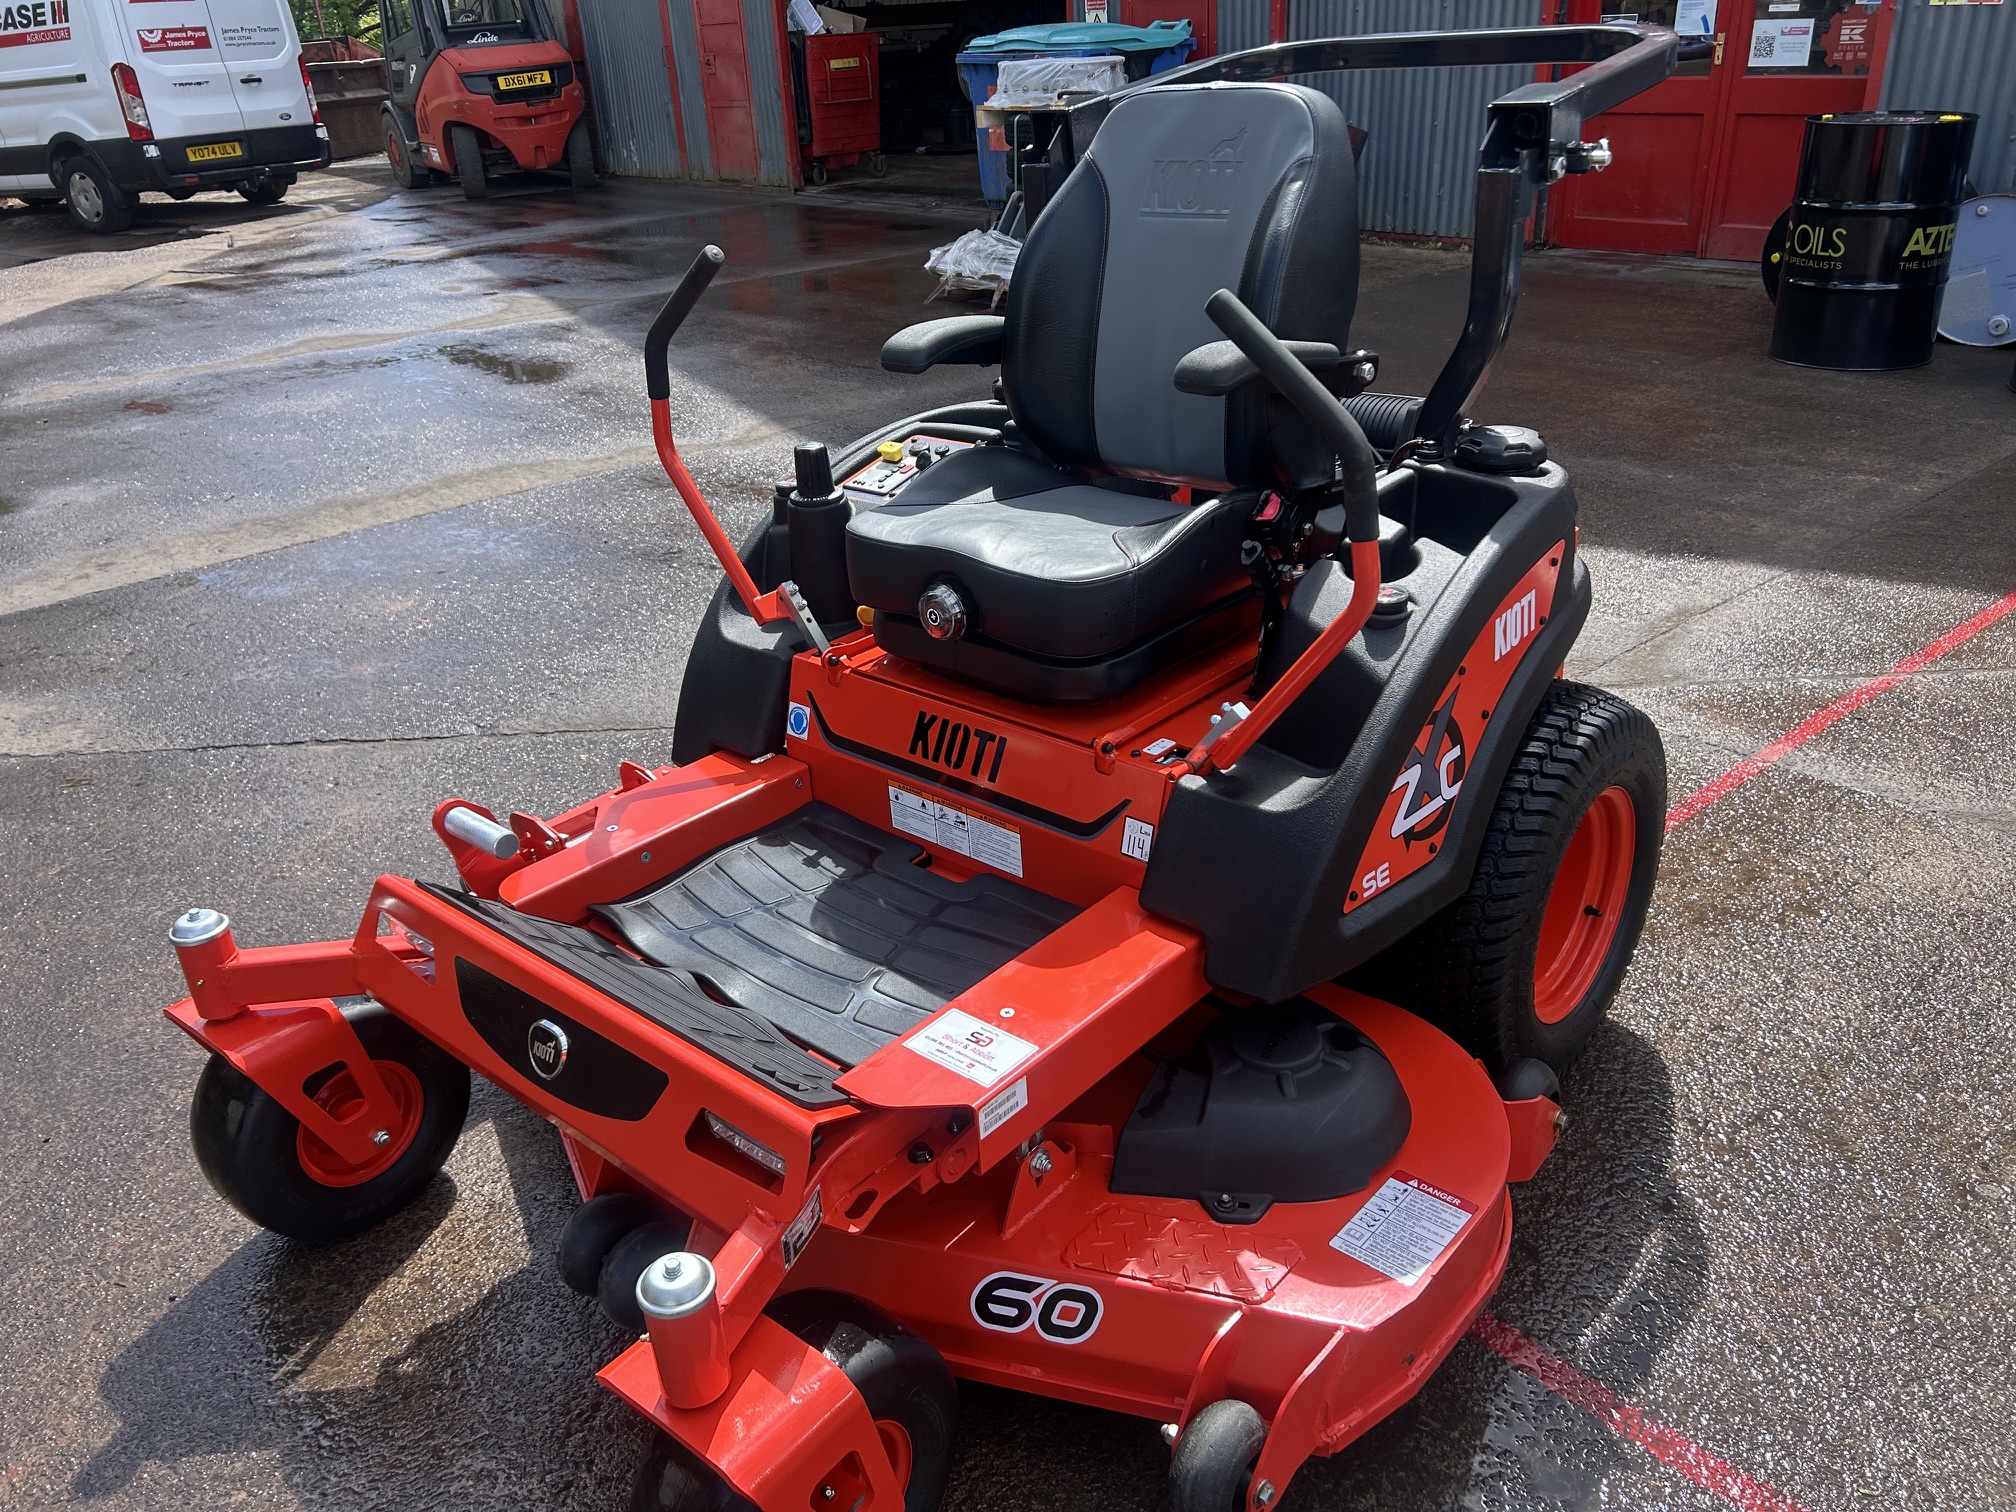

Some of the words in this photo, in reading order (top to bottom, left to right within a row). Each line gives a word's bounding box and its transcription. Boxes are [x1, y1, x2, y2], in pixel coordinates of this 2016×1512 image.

[0, 2, 47, 31] ASE
[26, 29, 70, 43] AGRICULTURE
[165, 31, 187, 39] James
[187, 30, 206, 38] Pryce
[221, 27, 240, 35] James
[240, 26, 257, 34] Pryce
[257, 25, 280, 33] Tractors
[467, 31, 499, 44] Linde
[504, 75, 526, 88] DX61
[526, 73, 546, 84] MFZ
[190, 145, 217, 159] YO74
[217, 144, 236, 156] ULV
[1140, 159, 1244, 212] KIOTI
[1794, 224, 1847, 258] OILS
[1789, 257, 1842, 270] SPECIALISTS
[1900, 261, 1919, 270] THE
[1494, 588, 1536, 662] KIOTI
[908, 709, 1008, 784] KIOTI
[1127, 834, 1145, 858] 114
[1363, 861, 1390, 899] SE
[533, 1040, 555, 1064] KIOTI
[942, 1034, 963, 1046] Short
[969, 1047, 995, 1061] Abbott
[1420, 1184, 1460, 1205] DANGER
[970, 1271, 1104, 1345] 60
